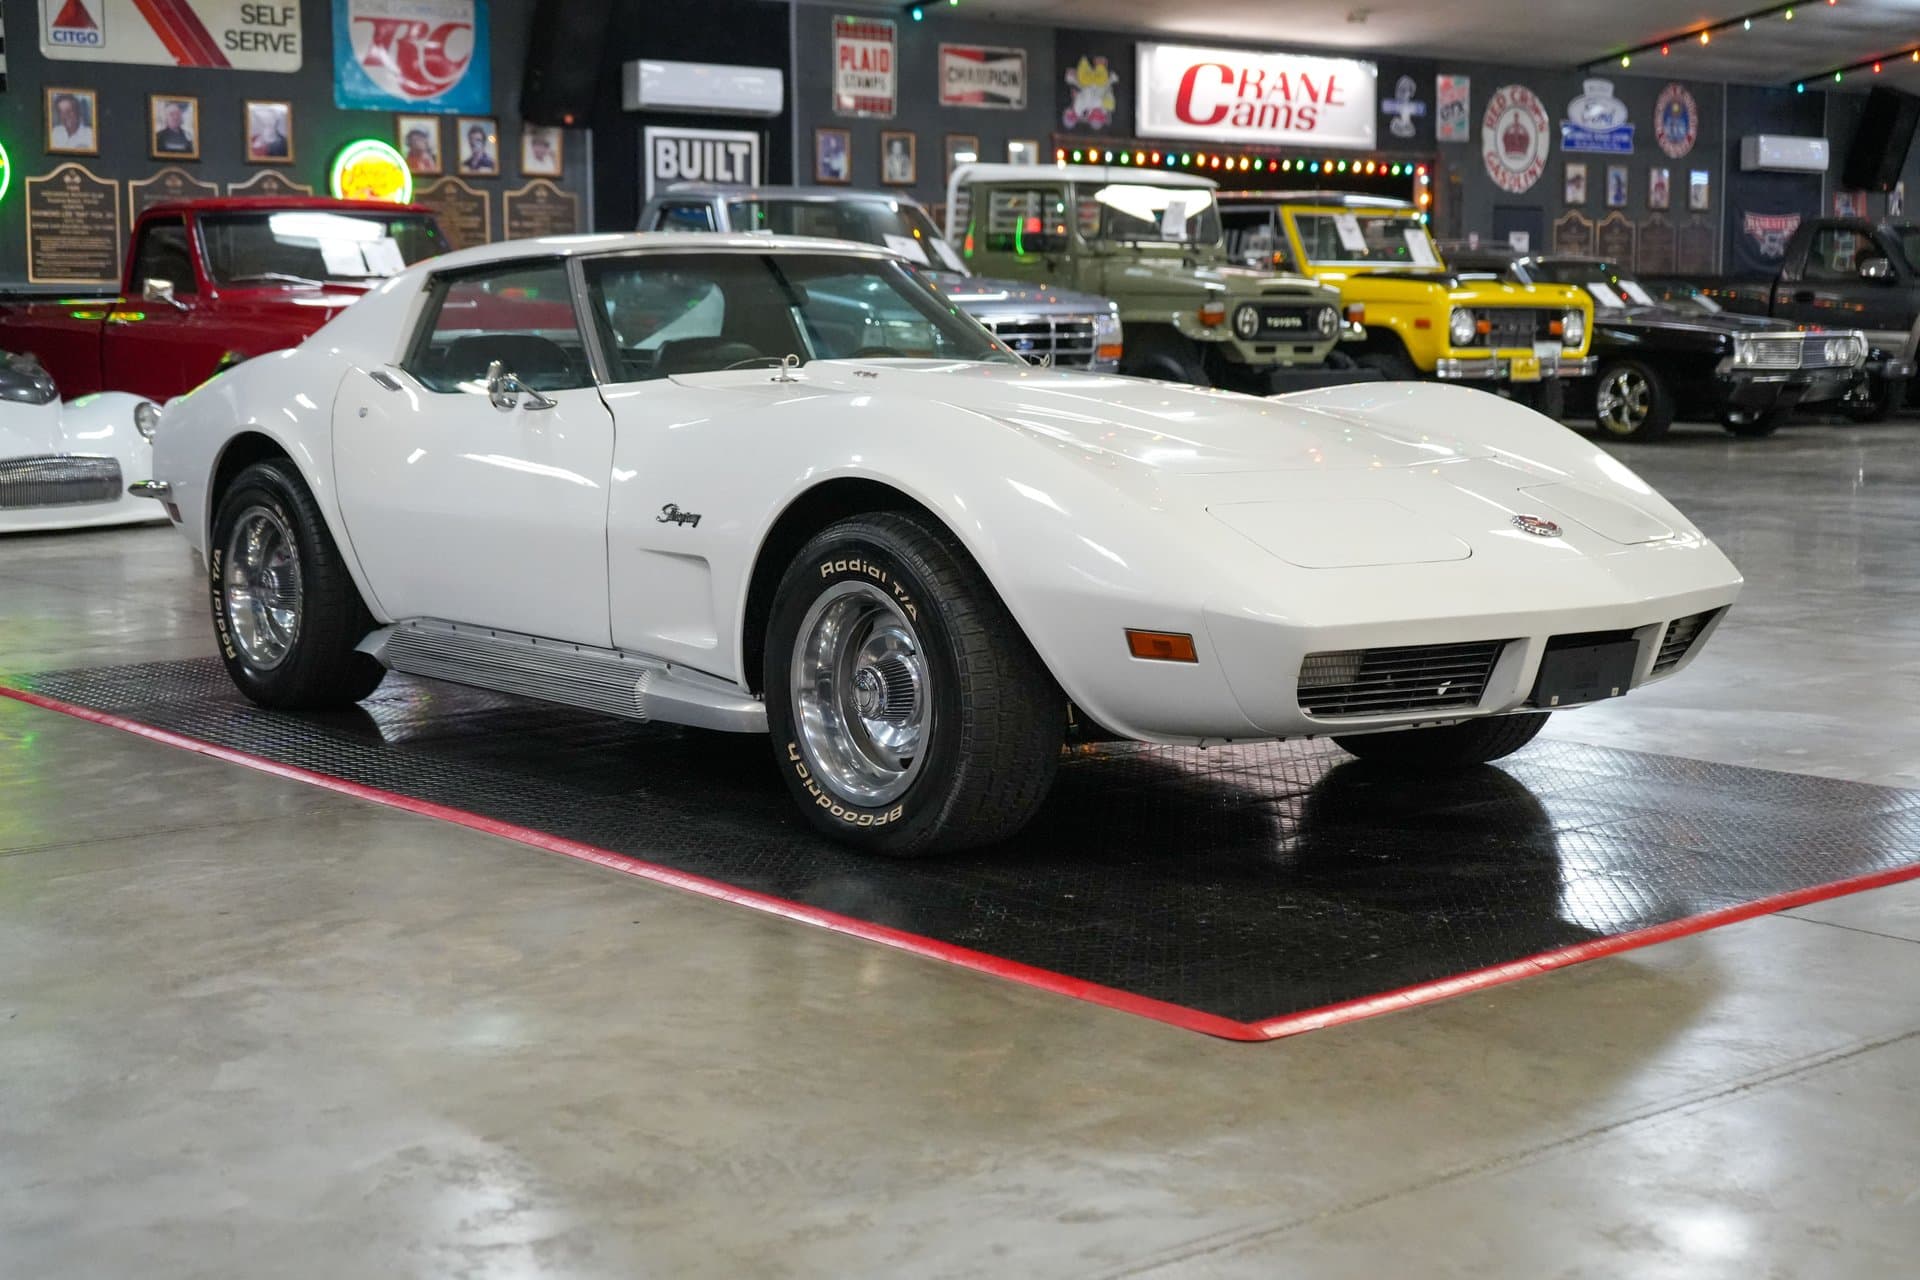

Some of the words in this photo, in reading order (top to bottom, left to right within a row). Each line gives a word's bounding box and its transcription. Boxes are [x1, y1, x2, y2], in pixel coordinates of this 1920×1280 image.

[240, 4, 296, 27] SELF
[52, 30, 99, 45] CITGO
[223, 29, 297, 54] SERVE
[353, 16, 472, 97] RC
[840, 45, 890, 75] PLAID
[948, 66, 1020, 88] CHAMPION
[1175, 63, 1345, 126] CRANE
[655, 139, 750, 183] BUILT
[1266, 316, 1303, 328] TOYOTA
[820, 558, 887, 583] Radial
[892, 581, 918, 622] T/A
[212, 590, 237, 660] Radial
[787, 743, 903, 827] BFGoodrich
